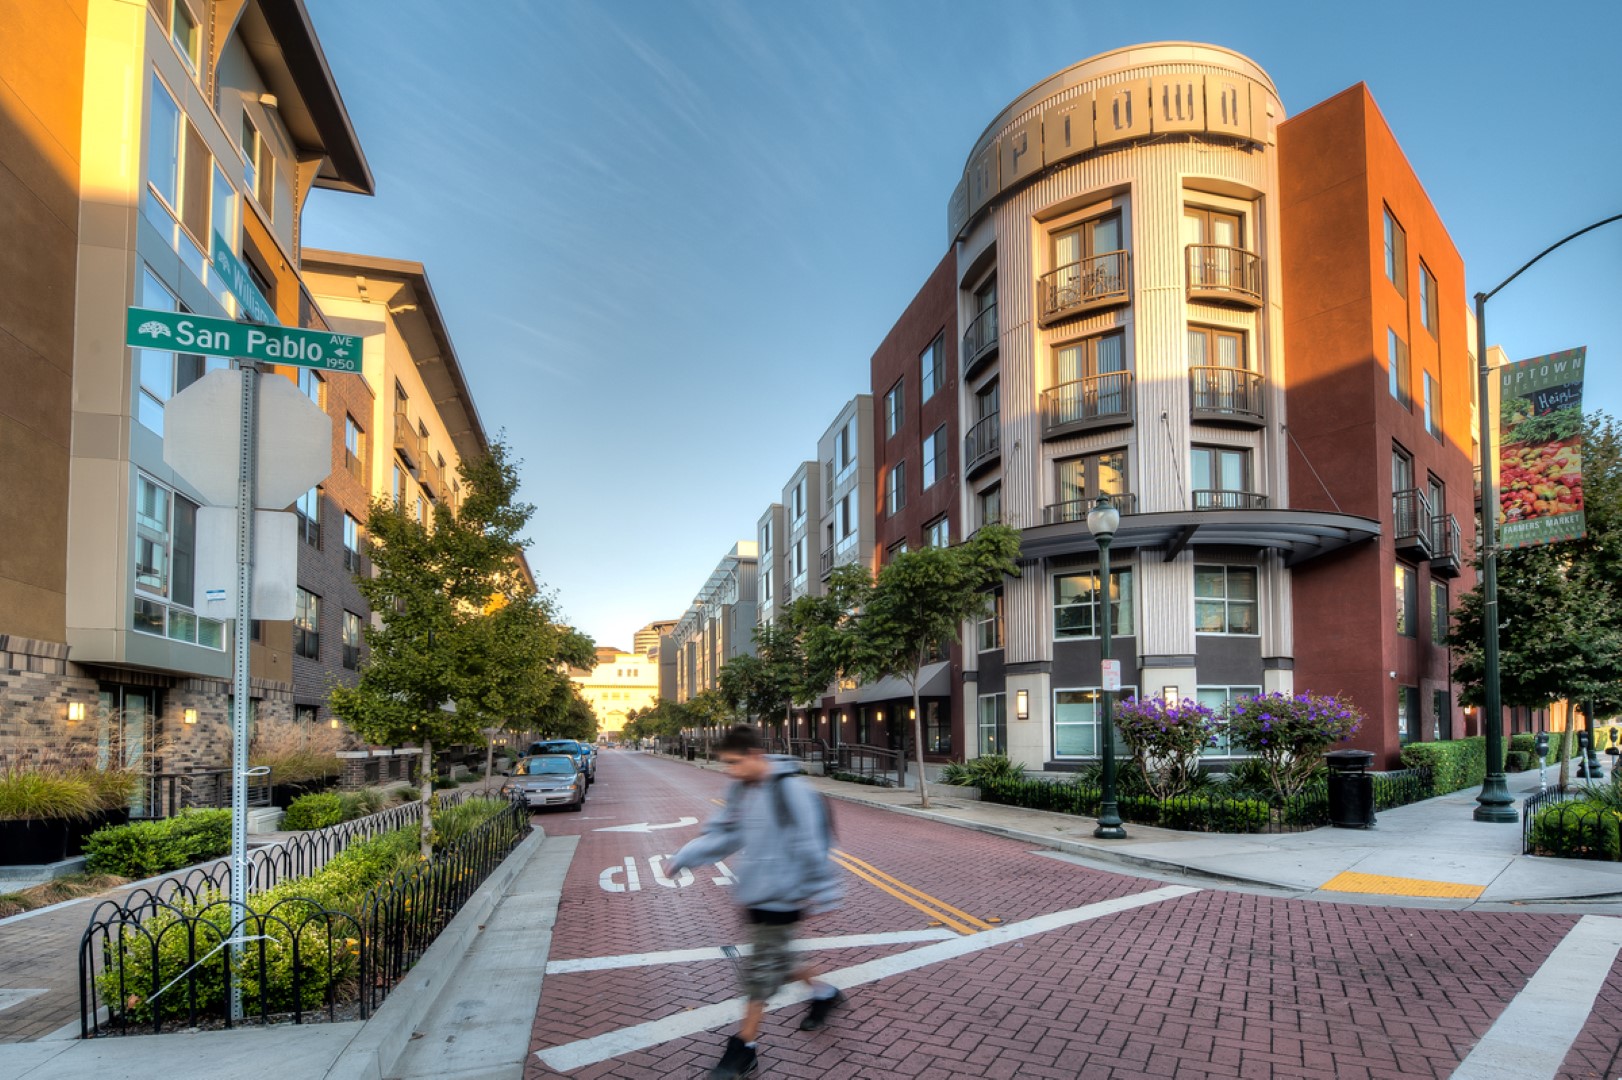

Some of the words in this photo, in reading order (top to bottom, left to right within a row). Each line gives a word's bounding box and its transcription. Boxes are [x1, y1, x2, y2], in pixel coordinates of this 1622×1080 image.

[176, 320, 230, 350] San
[247, 330, 323, 362] Pablo
[329, 334, 354, 348] AVE
[326, 357, 355, 371] 1950
[1503, 357, 1582, 386] UPTOWN
[1503, 370, 1580, 396] DISTRICT
[1545, 514, 1580, 528] MARKET
